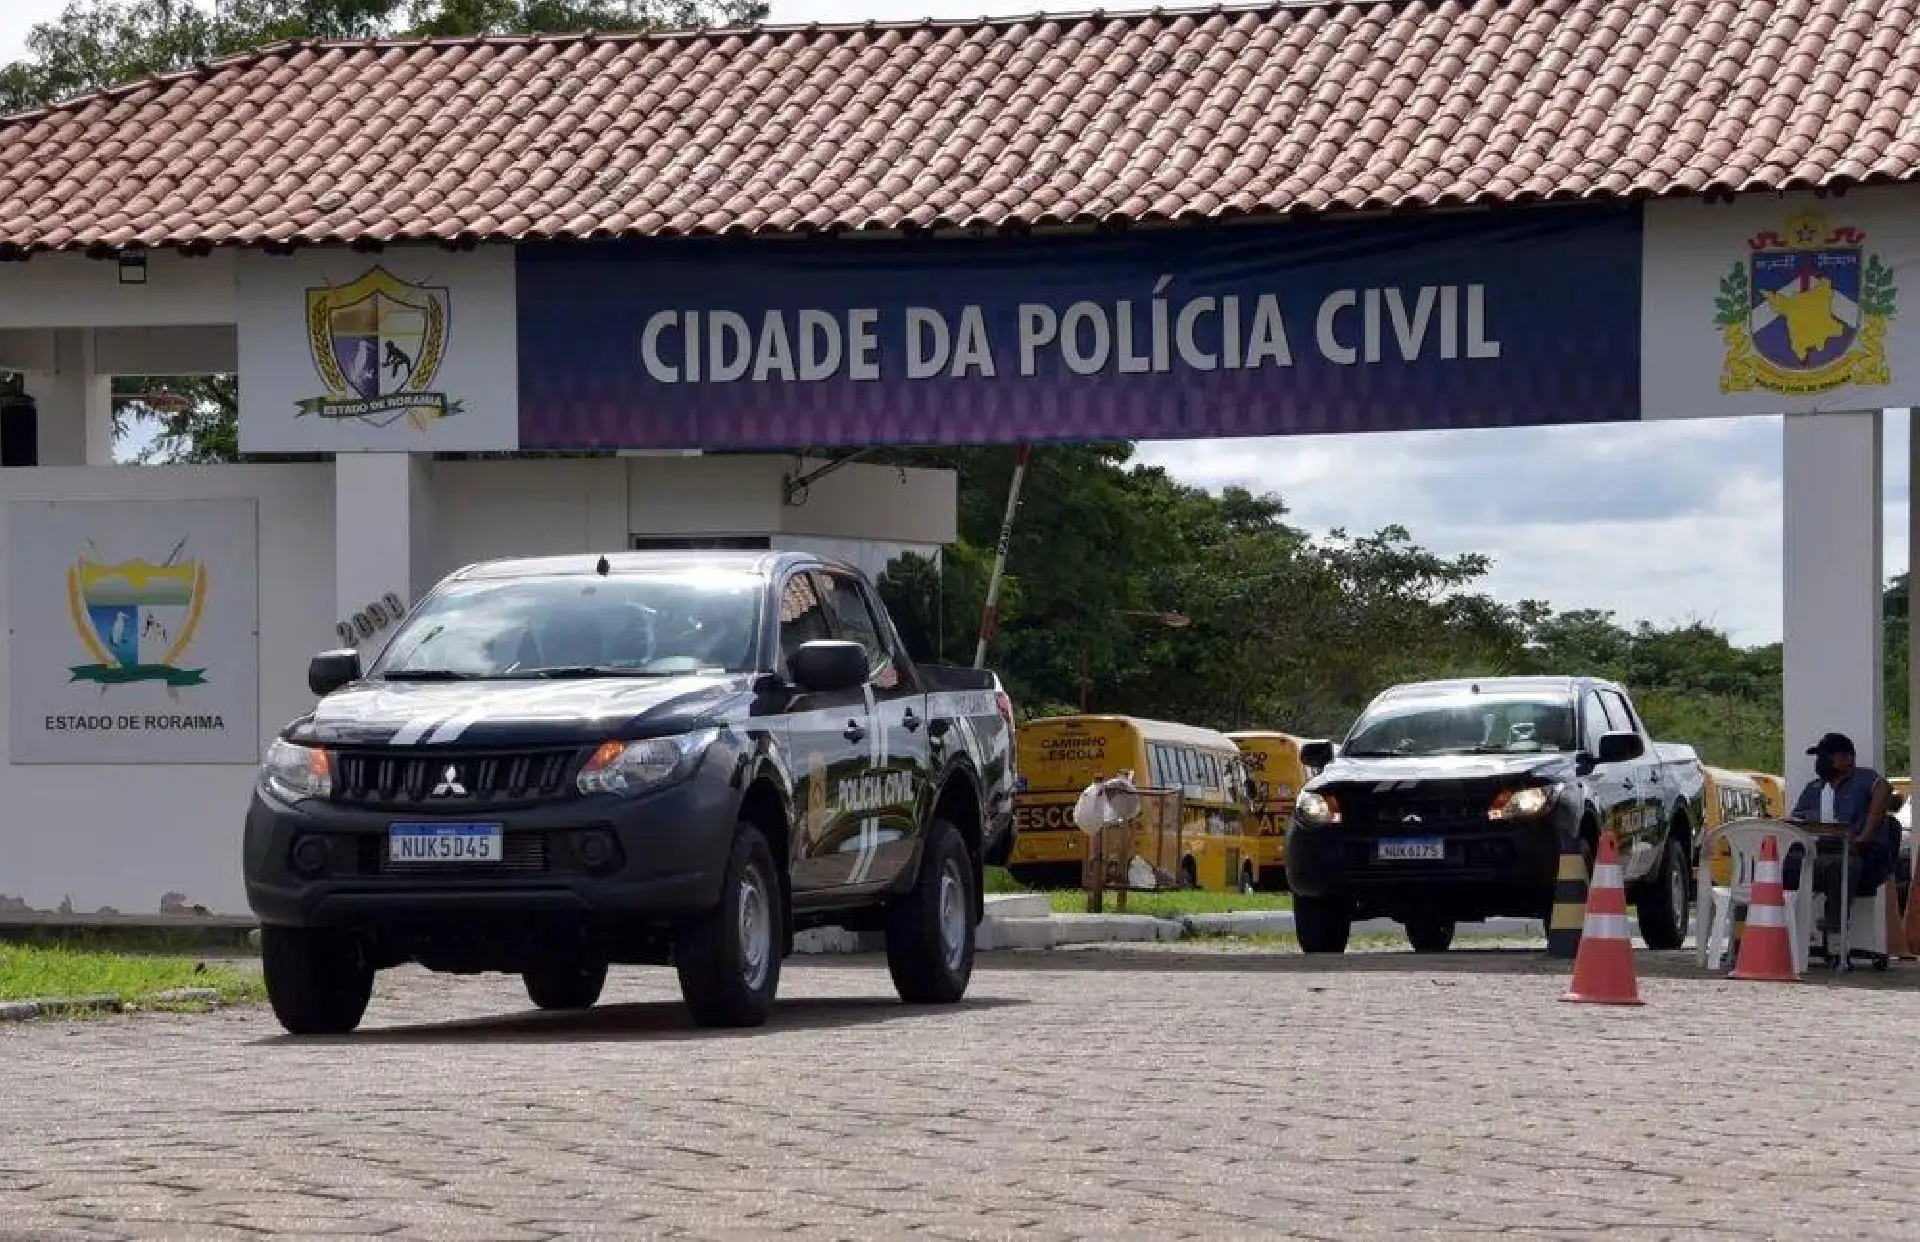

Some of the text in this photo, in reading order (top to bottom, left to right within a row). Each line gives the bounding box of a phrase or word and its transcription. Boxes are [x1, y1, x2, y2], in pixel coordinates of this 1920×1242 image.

[641, 275, 1500, 383] CIDADE DA POLÍCIA CIVIL
[45, 715, 225, 730] ESTADO DE RORAIMA
[1049, 748, 1105, 760] ESCOLA
